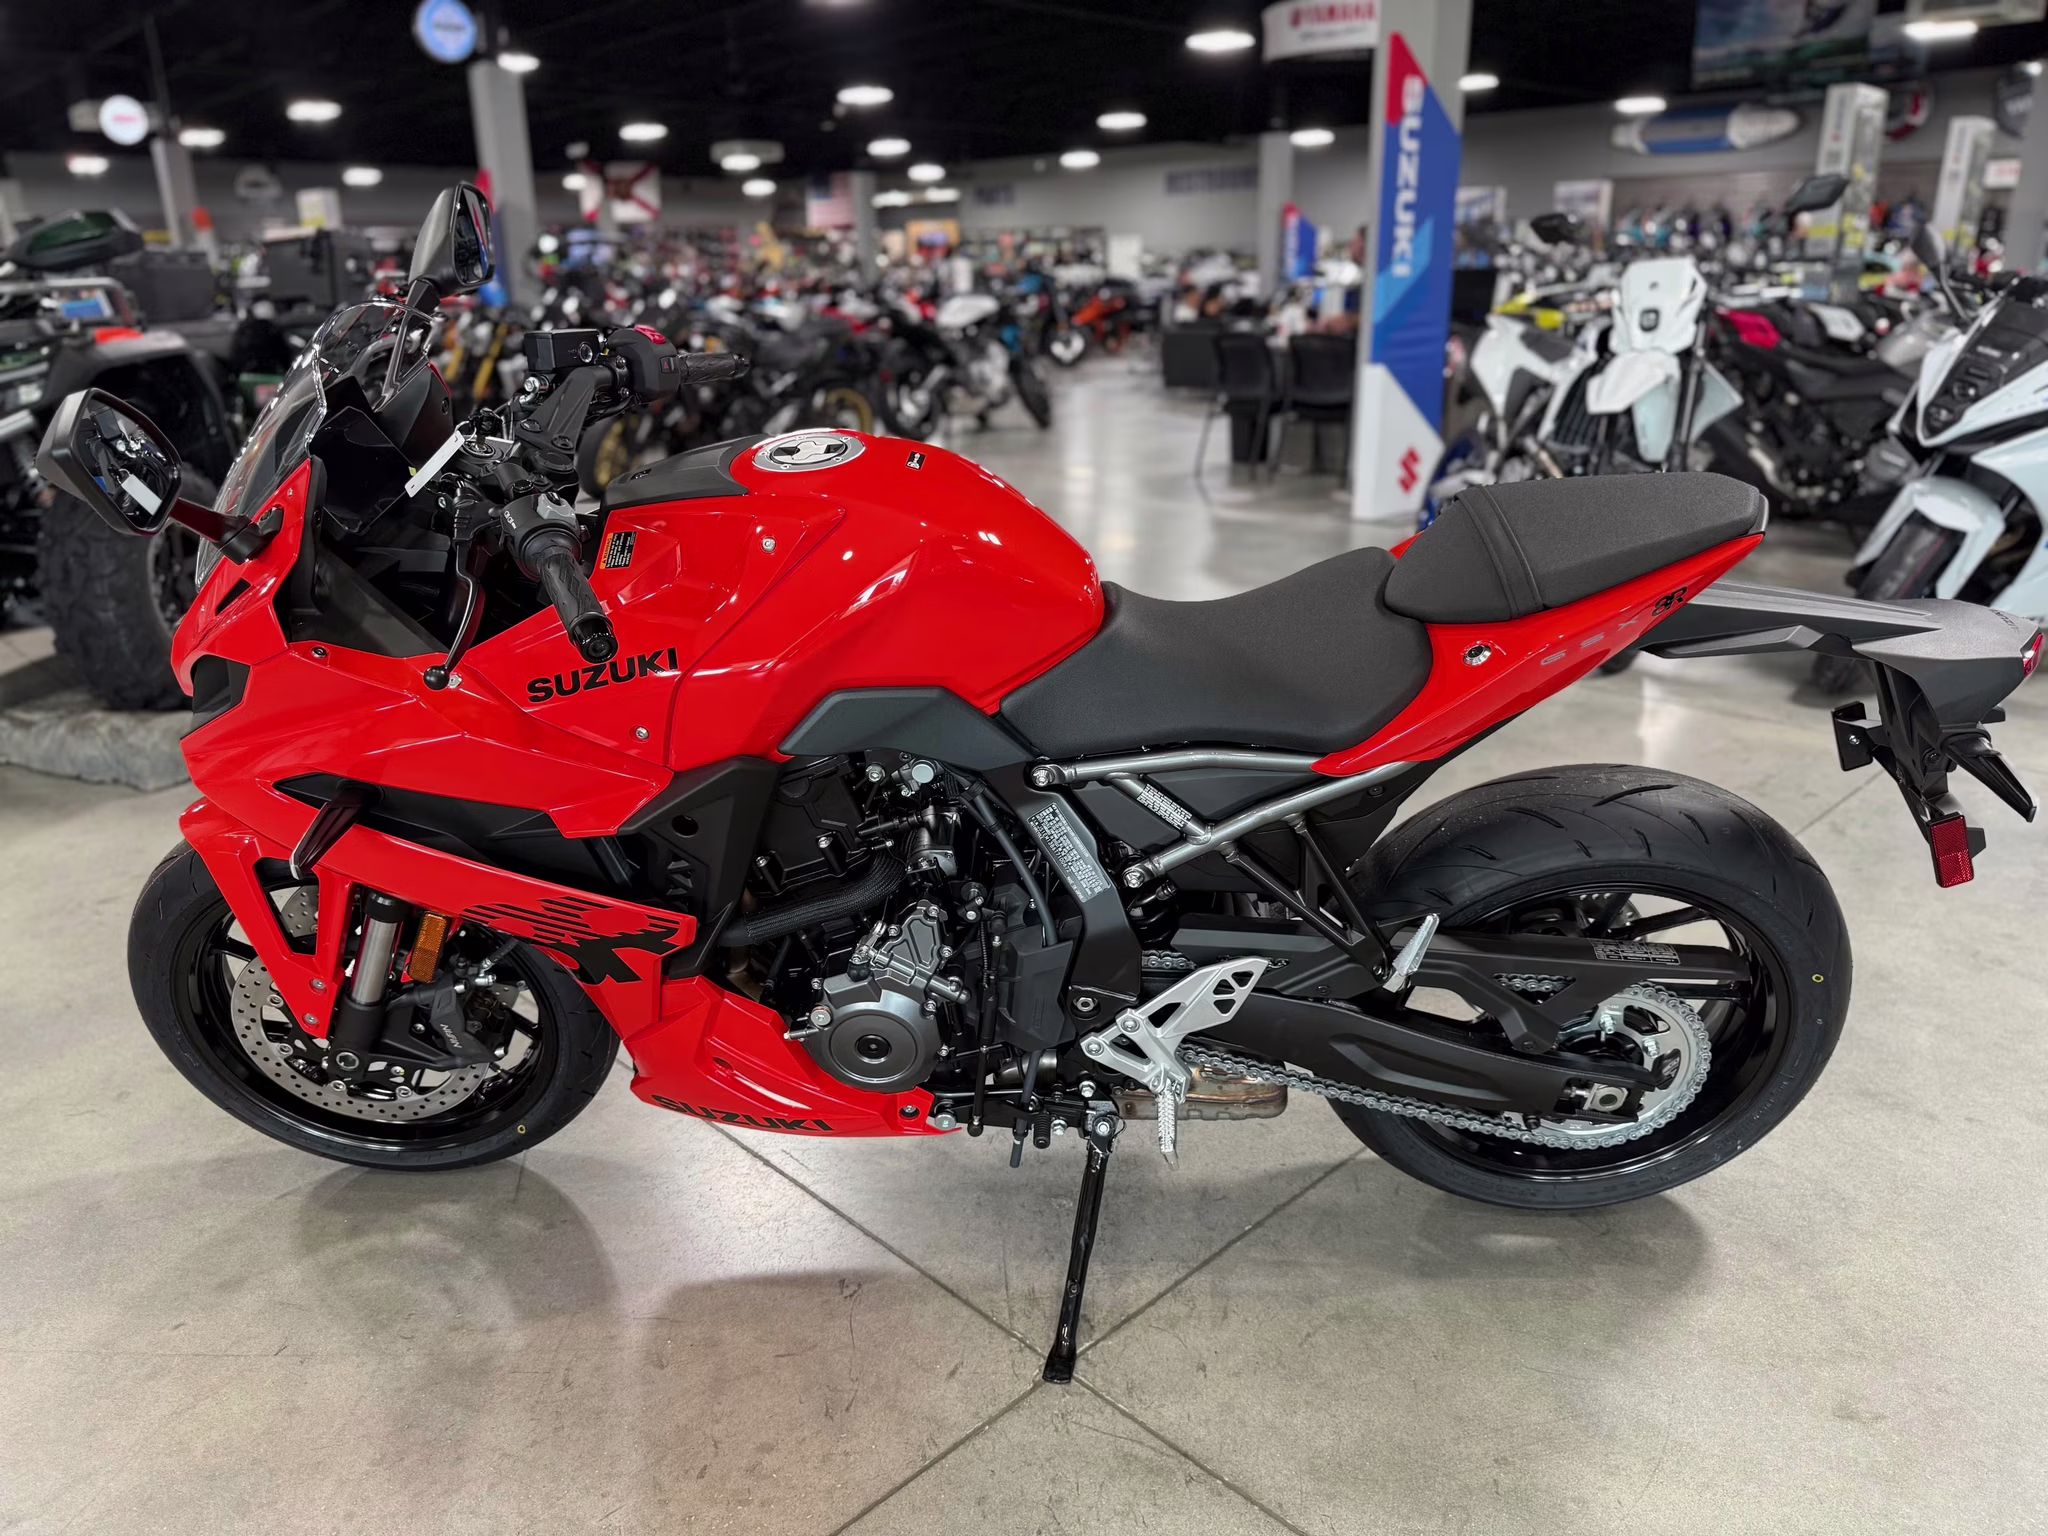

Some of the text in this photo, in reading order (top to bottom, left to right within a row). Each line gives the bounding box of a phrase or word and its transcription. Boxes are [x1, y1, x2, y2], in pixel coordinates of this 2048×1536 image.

[1392, 75, 1425, 277] SUZUKI
[527, 647, 678, 703] SUZUKI
[651, 1095, 834, 1131] SUZUKI
